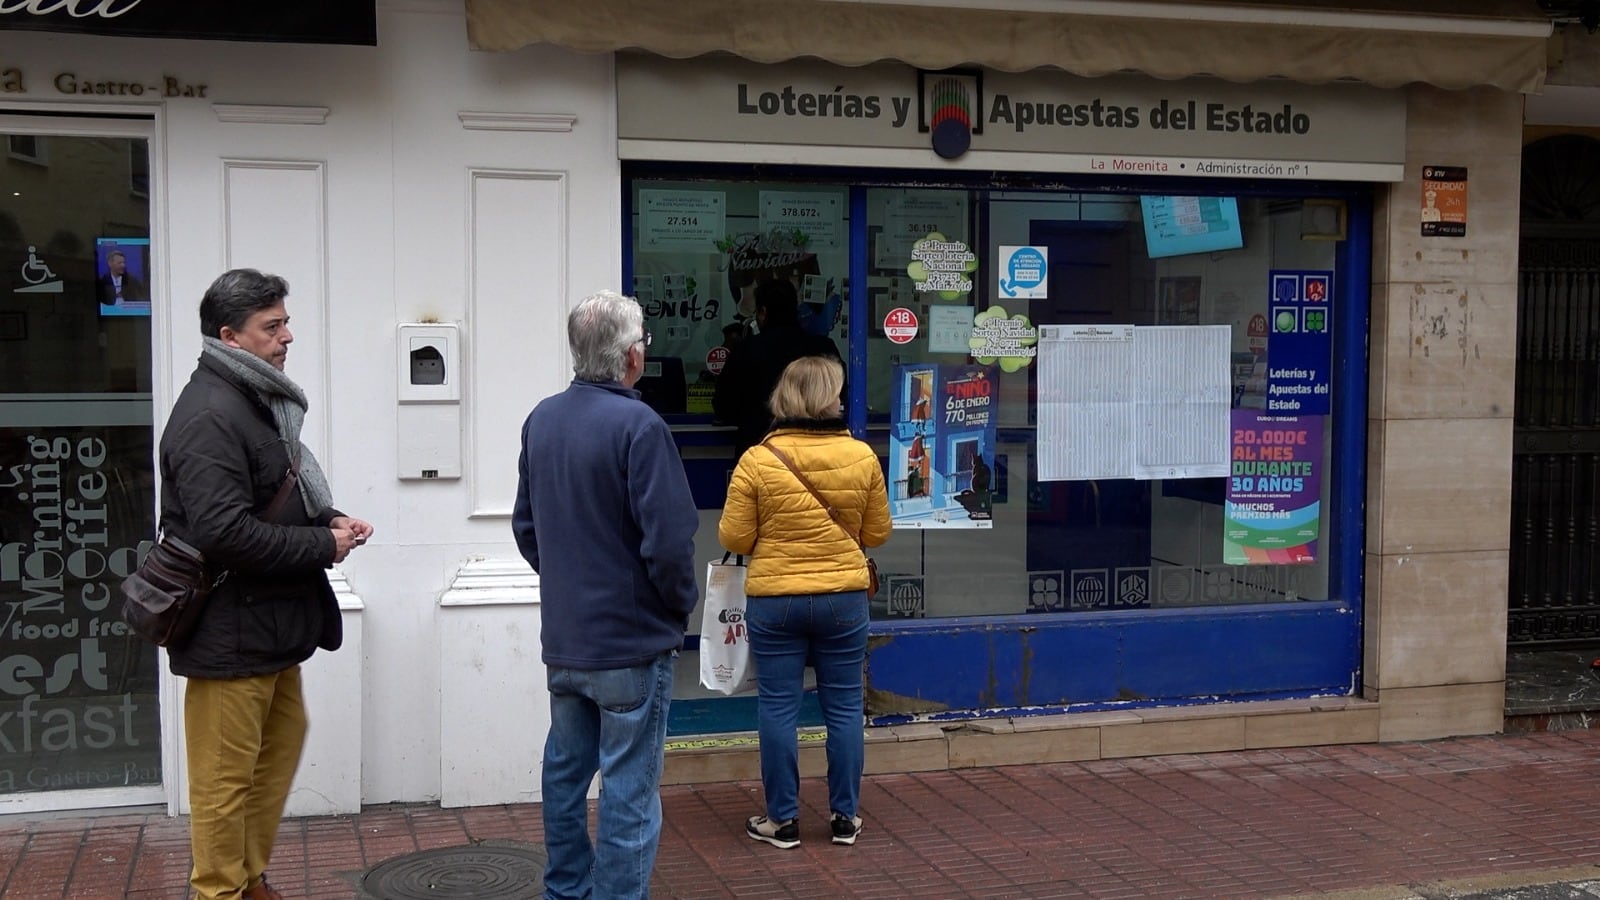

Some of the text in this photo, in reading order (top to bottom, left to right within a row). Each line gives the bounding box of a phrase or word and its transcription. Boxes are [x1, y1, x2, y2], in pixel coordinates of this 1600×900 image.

[54, 73, 208, 99] Gastro-Bar
[737, 83, 911, 128] Loterías y
[989, 94, 1310, 134] Apuestas del Estado
[1091, 159, 1168, 172] La Morenita
[1196, 162, 1283, 176] Administración
[1304, 165, 1310, 176] 1
[1424, 182, 1465, 191] SEGURIDAD
[667, 217, 698, 226] 27.514
[932, 241, 967, 251] Premio
[911, 250, 942, 260] Sorteo
[923, 261, 966, 271] Nacional
[890, 312, 910, 324] +18
[995, 318, 1024, 328] Premio
[972, 328, 1036, 338] Sorteo Navidad
[711, 350, 727, 359] +18
[1270, 368, 1316, 380] Loterías y
[1269, 384, 1328, 396] Apuestas del
[946, 396, 990, 410] 6 DE ENERO
[1269, 400, 1301, 410] Estado
[945, 409, 965, 424] 770
[1233, 429, 1307, 445] 20.000€
[1233, 446, 1294, 461] AL MES
[1232, 461, 1313, 476] DURANTE
[1231, 474, 1304, 492] 30 AÑOS
[1239, 503, 1275, 511] MUCHOS
[1230, 509, 1291, 520] PREMIOS MÁS
[22, 435, 72, 616] Morning
[65, 436, 111, 611] coffee
[12, 618, 79, 640] food
